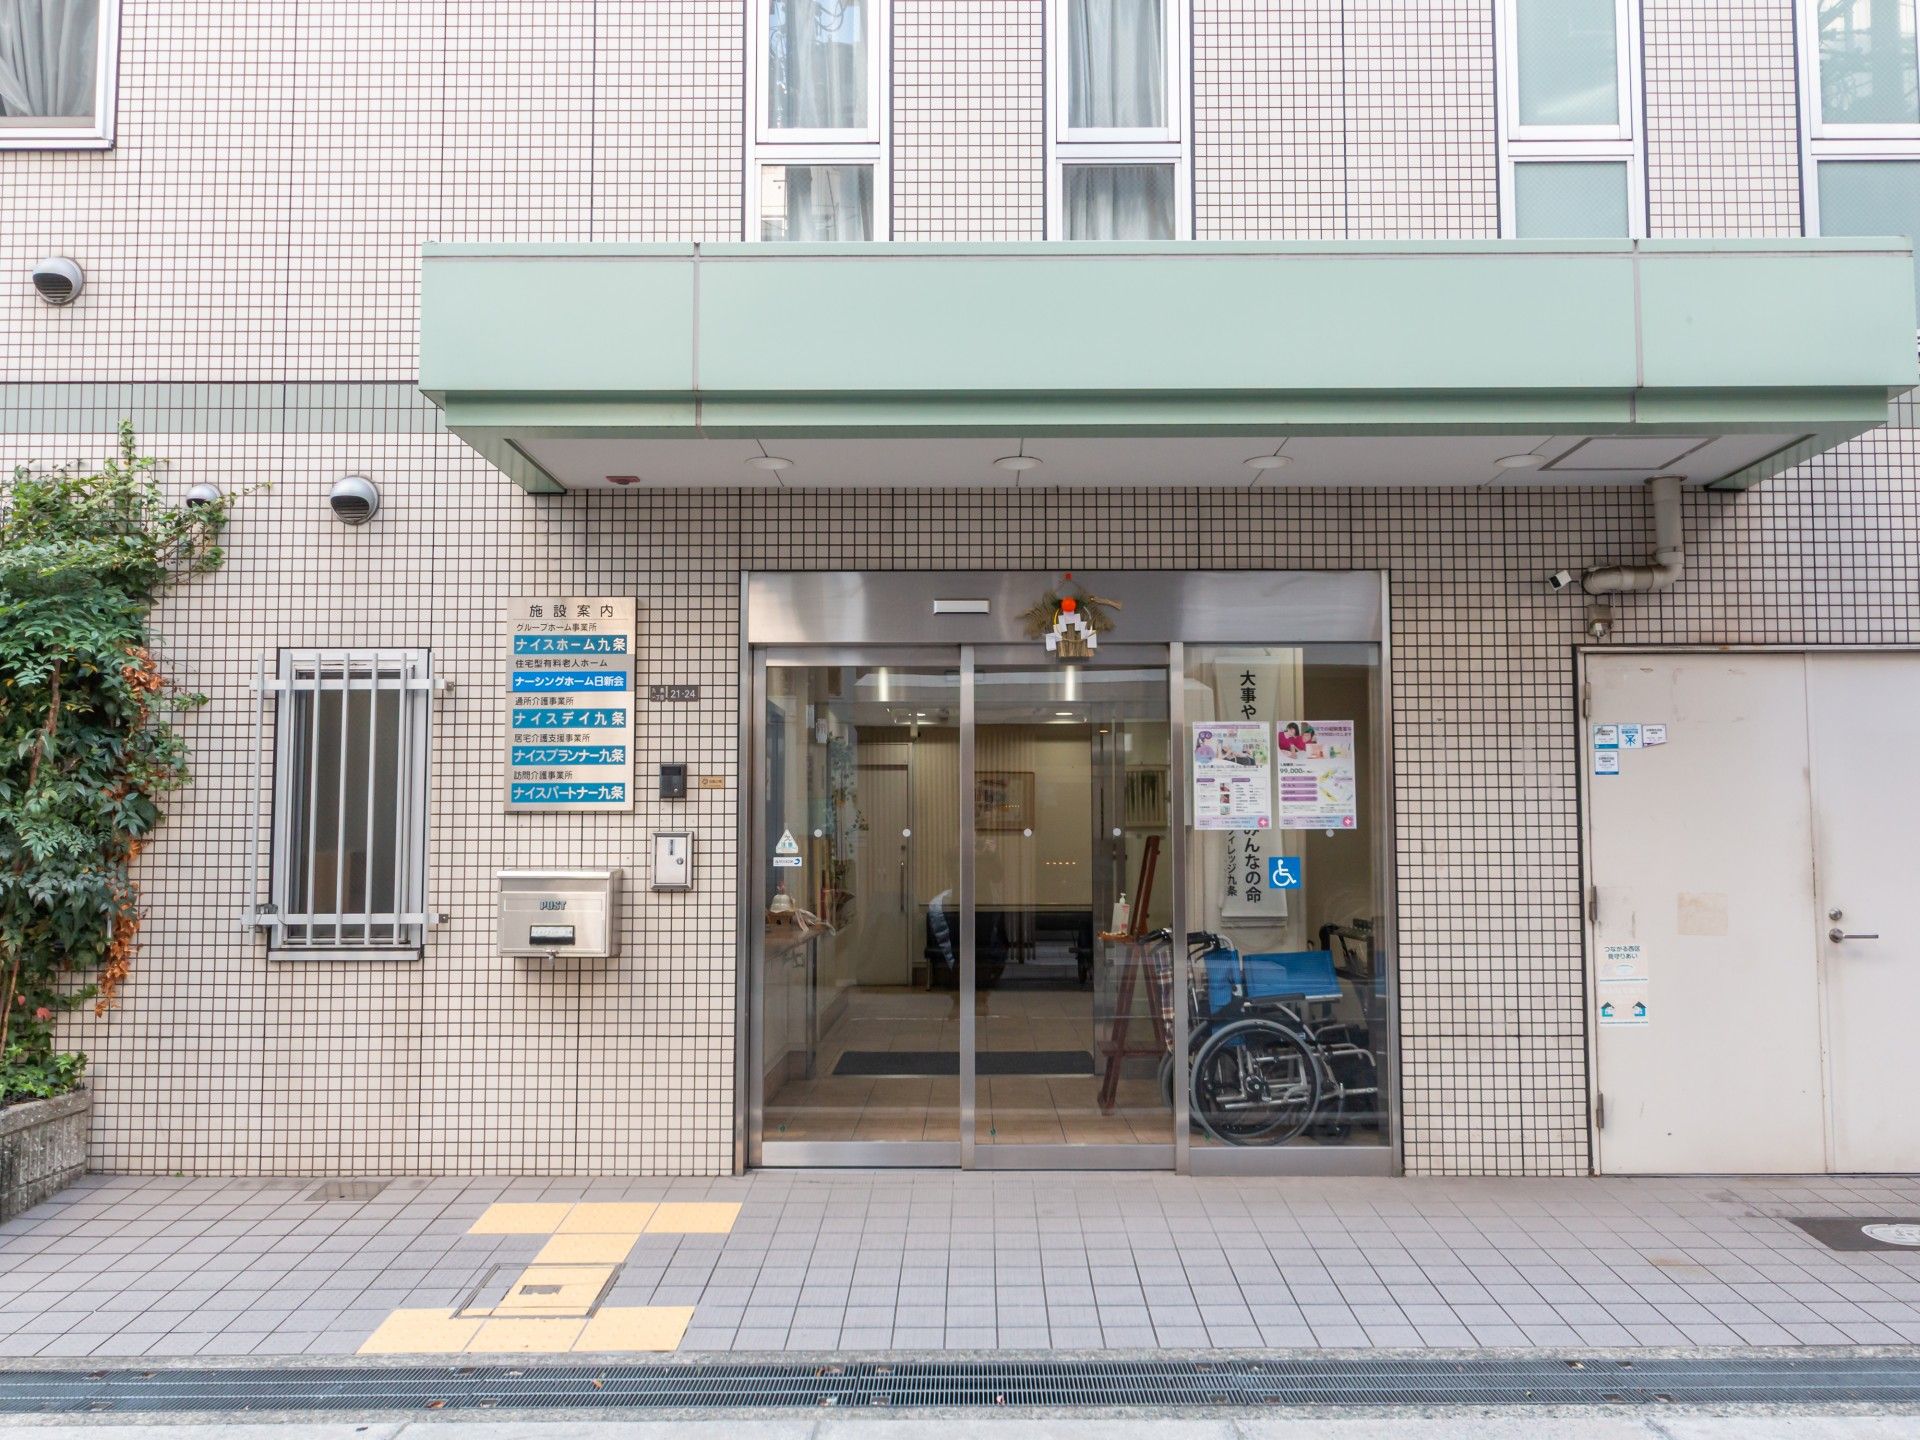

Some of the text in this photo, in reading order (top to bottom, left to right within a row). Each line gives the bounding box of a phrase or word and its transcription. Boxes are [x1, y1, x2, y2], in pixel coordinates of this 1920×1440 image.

[529, 604, 614, 618] 施設案内
[516, 622, 598, 632] グループホーム事業所
[516, 638, 626, 652] ナイスホーム九条
[515, 659, 608, 668] 住宅型有料老人ホーム
[514, 676, 625, 687] ナーシングホーム日新会
[1240, 670, 1257, 720] 大事や
[514, 697, 574, 706] 通所介護事業所
[514, 711, 626, 726] ナイスデイ九条
[514, 734, 591, 743] 居宅介護支援事業所
[513, 749, 625, 763] ナイスプランナー九条
[513, 771, 574, 780] 訪問介護事業所
[513, 786, 625, 800] ナイスパートナー九条
[539, 900, 567, 911] POST
[1604, 945, 1641, 953] つながる西区
